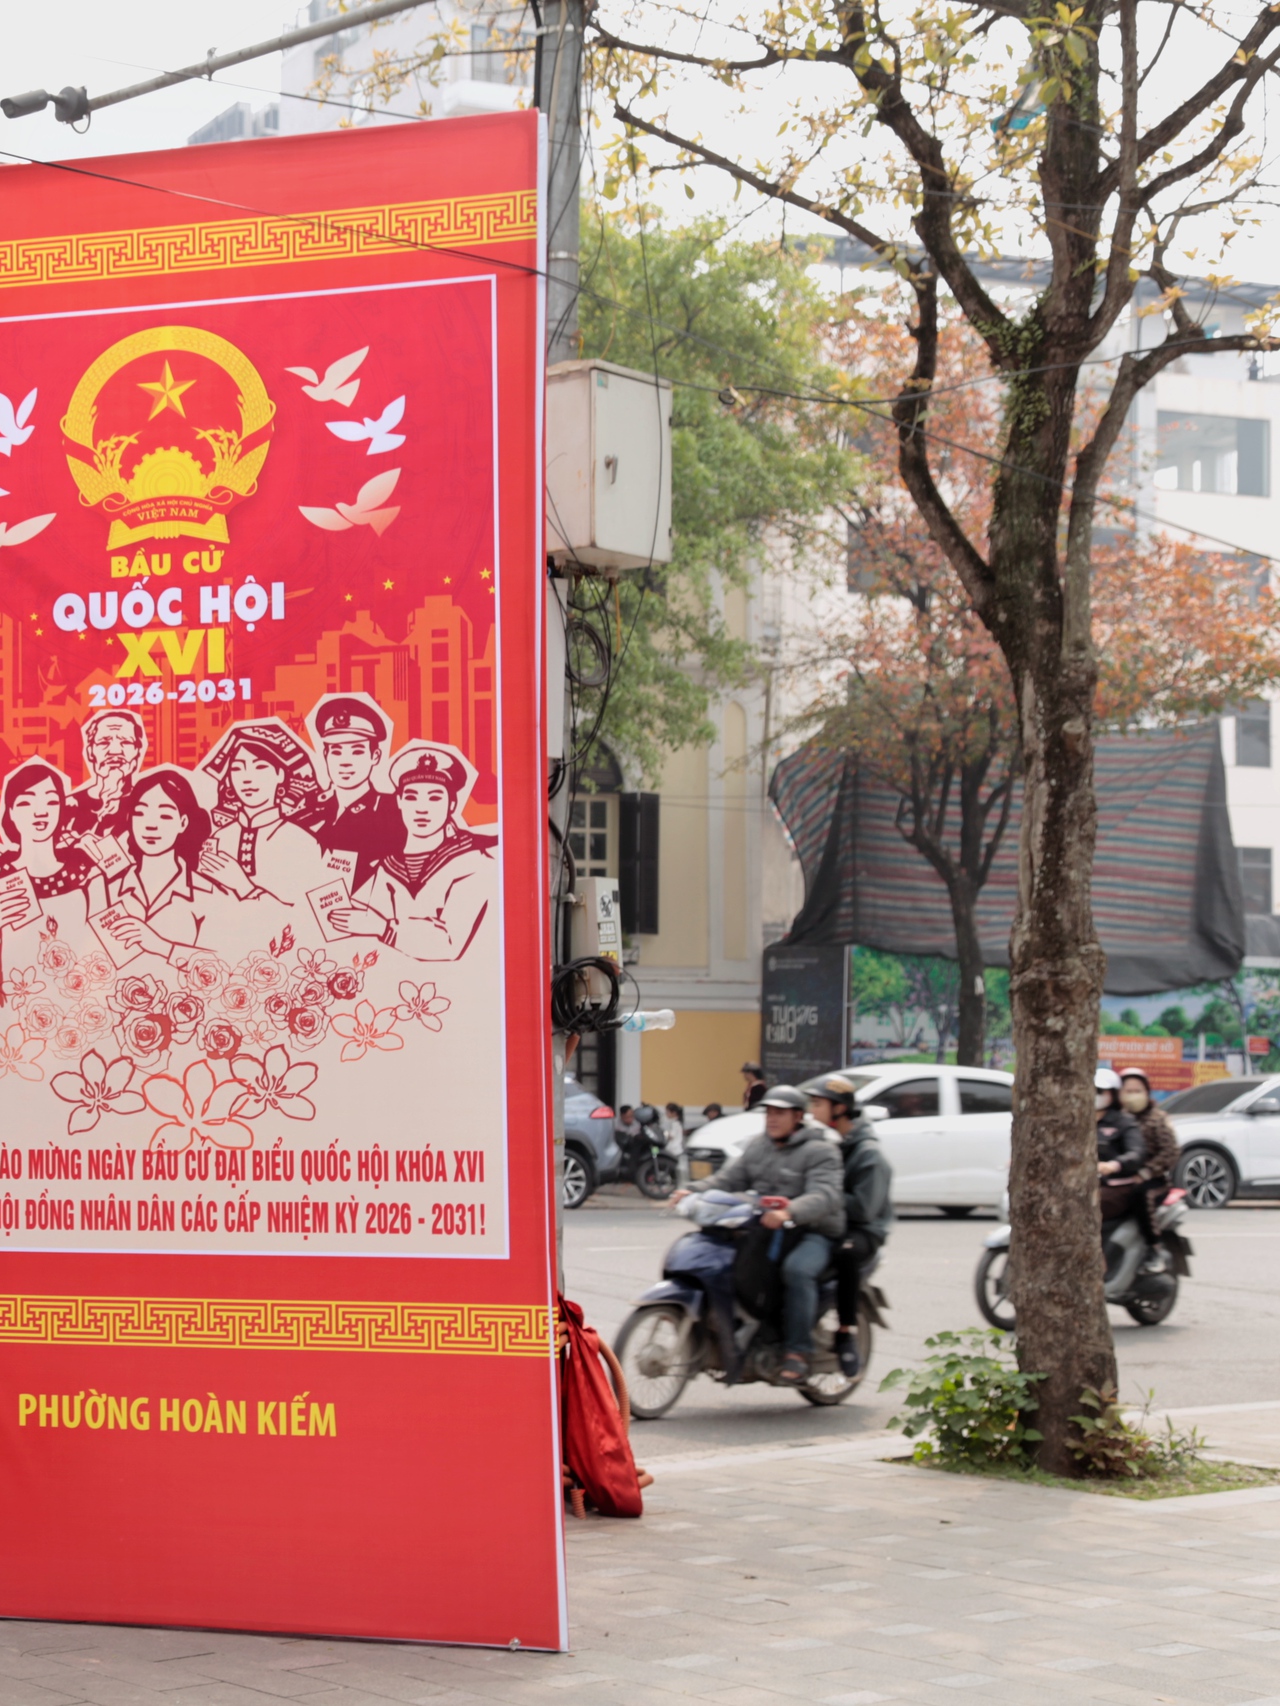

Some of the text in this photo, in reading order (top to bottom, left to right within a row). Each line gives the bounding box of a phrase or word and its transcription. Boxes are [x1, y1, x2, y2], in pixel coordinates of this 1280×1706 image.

[137, 507, 199, 521] VIỆT NAM
[111, 544, 225, 578] BẦU CỬ
[52, 575, 285, 633] QUỐC HỘI
[115, 628, 225, 678] XVI
[88, 678, 251, 707] 2026-2031
[28, 1141, 82, 1180] MỪNG
[88, 1142, 136, 1180] NGÀY
[142, 1138, 178, 1180] BẦU
[184, 1136, 212, 1181] CỬ
[214, 1150, 246, 1188] ĐẠI
[252, 1136, 294, 1181] BIỂU
[301, 1138, 351, 1185] QUỐC
[357, 1143, 389, 1189] HỘI
[395, 1143, 447, 1182] KHÓA
[453, 1150, 484, 1182] XVI
[25, 1188, 74, 1230] ĐỒNG
[80, 1193, 131, 1231] NHÂN
[137, 1194, 175, 1232] DÂN
[181, 1194, 217, 1232] CÁC
[224, 1190, 261, 1233] CẤP
[268, 1194, 329, 1240] NHIỆM
[335, 1195, 359, 1234] KỲ
[365, 1202, 412, 1234] 2026
[431, 1203, 485, 1235] 2031!
[19, 1389, 337, 1437] PHƯỜNG HOÀN KIẾM
